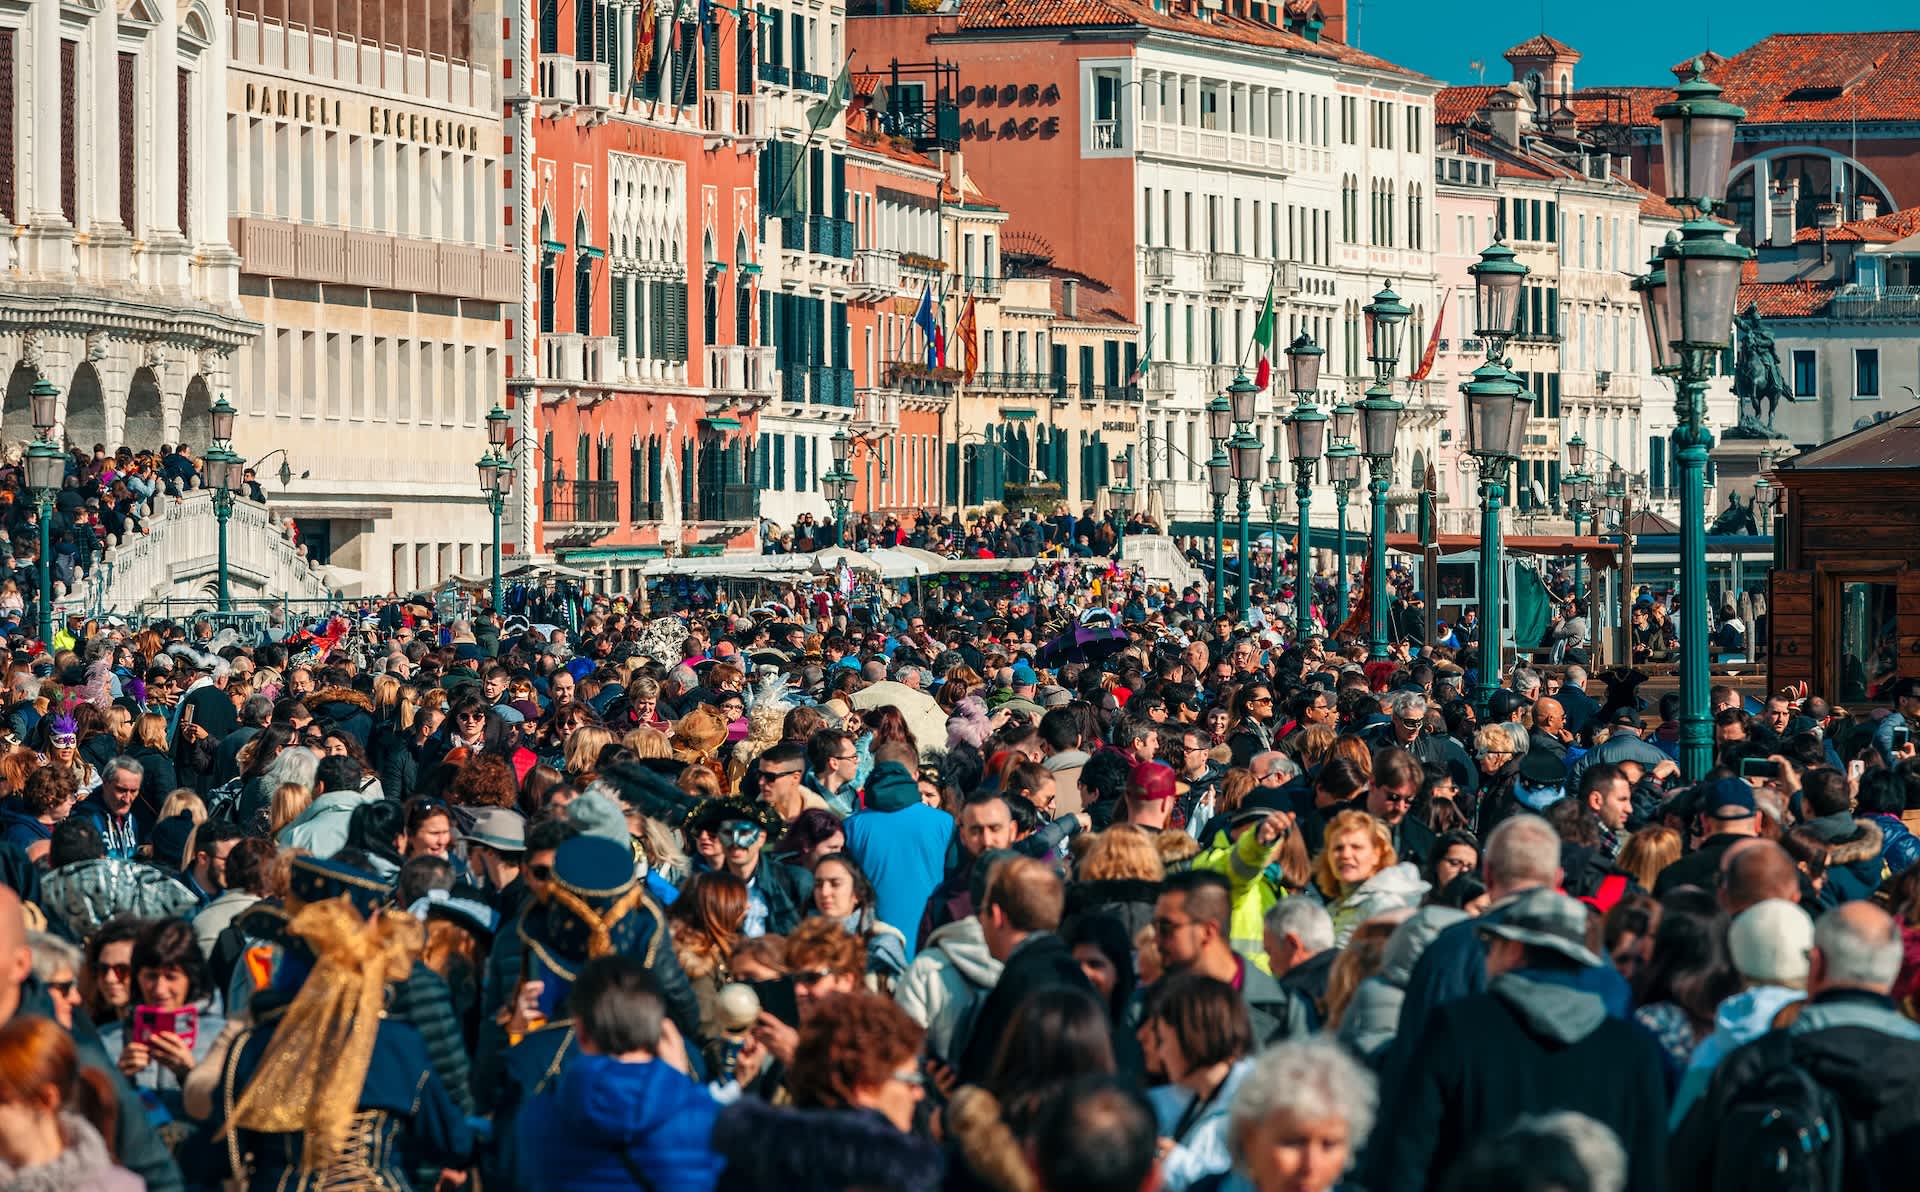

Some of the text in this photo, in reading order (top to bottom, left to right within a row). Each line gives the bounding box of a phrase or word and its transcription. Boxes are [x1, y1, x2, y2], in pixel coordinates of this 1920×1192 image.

[246, 83, 477, 151] DANIELI EXCELSIOR
[960, 116, 1060, 140] ALACE
